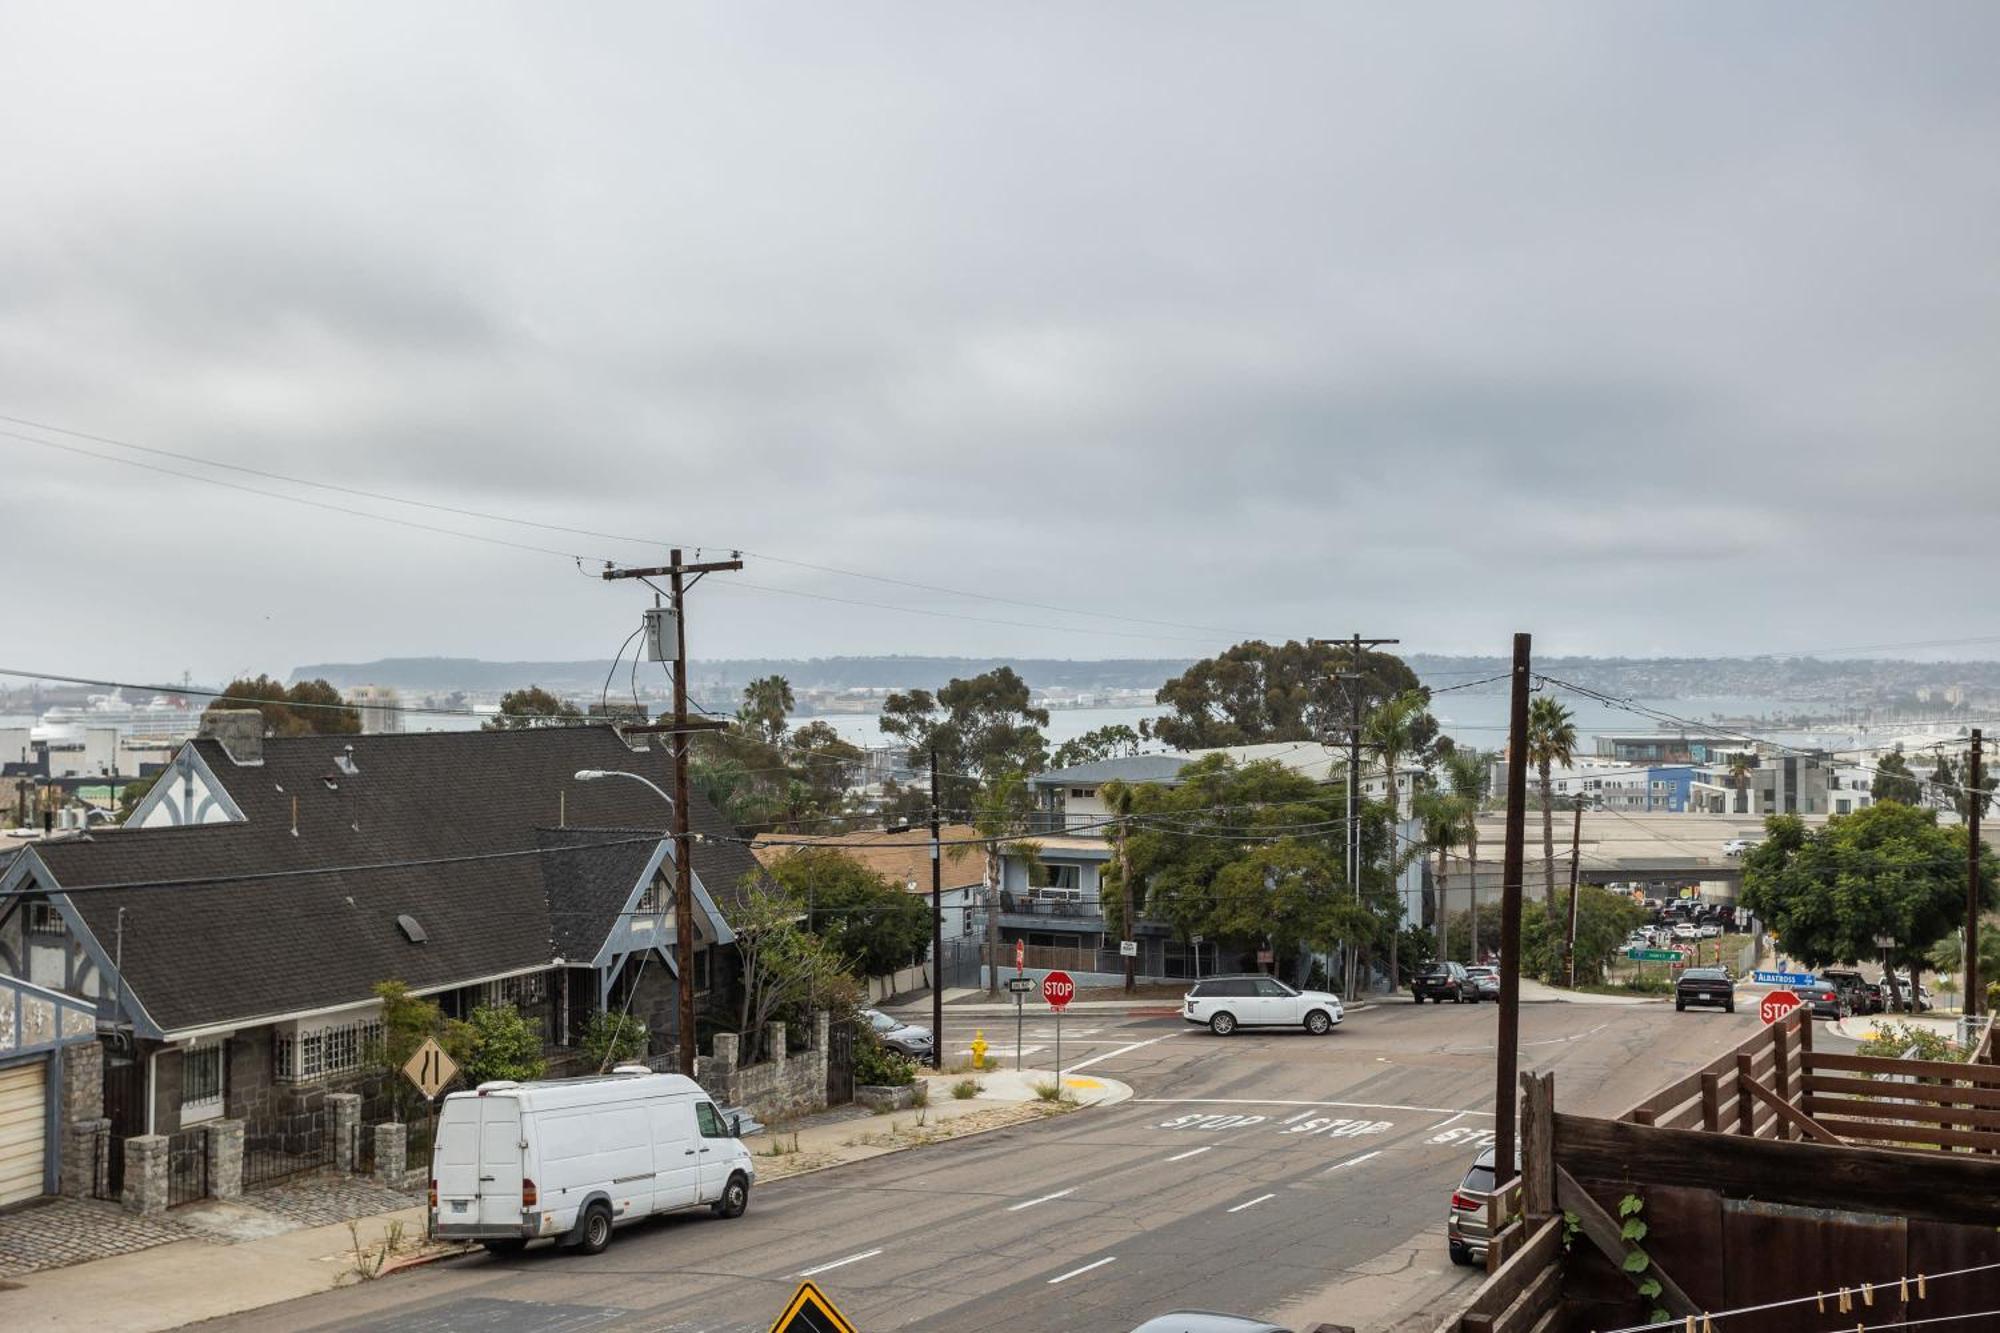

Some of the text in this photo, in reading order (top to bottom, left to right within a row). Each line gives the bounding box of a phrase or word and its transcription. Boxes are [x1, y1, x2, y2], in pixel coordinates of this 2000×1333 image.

[1758, 973, 1796, 983] ALBATROSS
[1044, 982, 1073, 996] STOP
[1763, 1003, 1797, 1019] STO
[1160, 1114, 1264, 1131] STOP
[1288, 1118, 1394, 1137] STOP
[1424, 1127, 1521, 1148] STO
